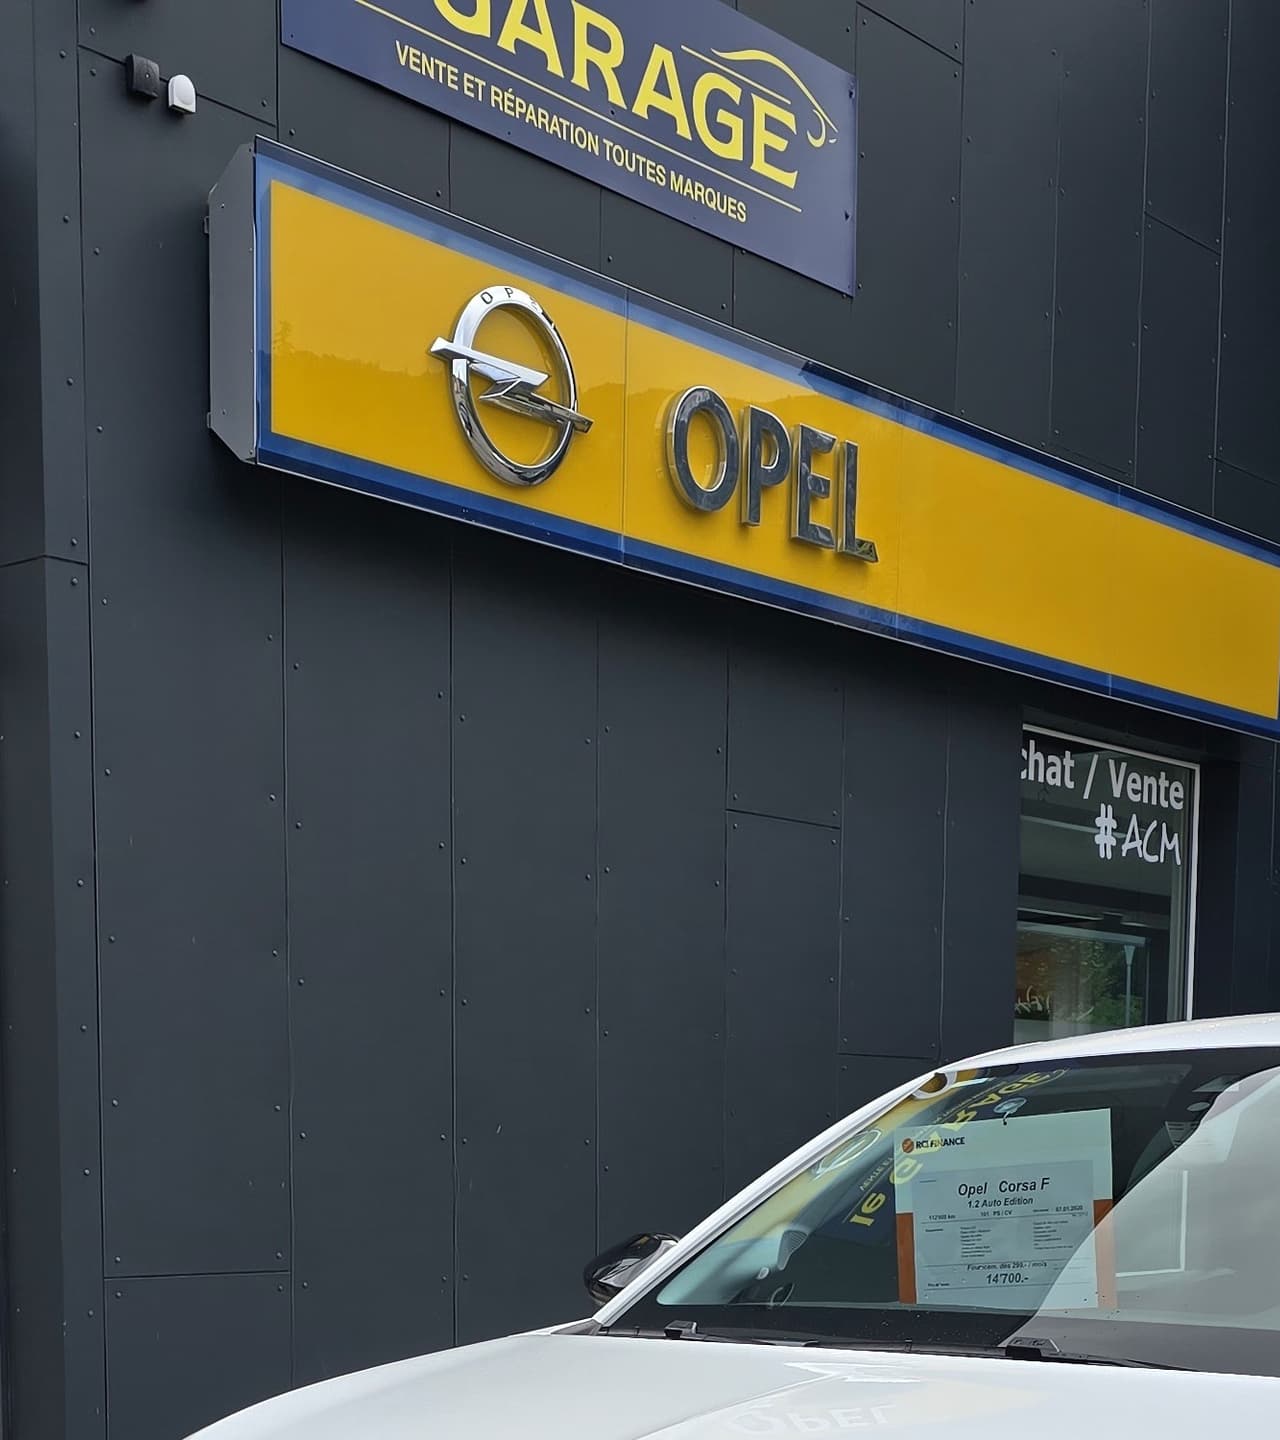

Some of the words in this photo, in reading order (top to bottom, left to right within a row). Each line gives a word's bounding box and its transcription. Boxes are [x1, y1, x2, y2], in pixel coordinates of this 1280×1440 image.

[394, 40, 458, 91] VENTE
[463, 73, 486, 102] ET
[490, 86, 600, 156] RÉPARATION
[603, 138, 667, 184] TOUTES
[670, 170, 748, 223] MARQUES
[666, 386, 879, 562] OPEL
[1083, 754, 1099, 800] /
[1108, 758, 1185, 811] Vente
[958, 1182, 988, 1198] Opel
[999, 1179, 1037, 1194] Corsa
[1040, 1177, 1051, 1190] F
[967, 1199, 980, 1209] 1.2
[981, 1199, 1002, 1208] Auto
[1004, 1196, 1034, 1207] Edition
